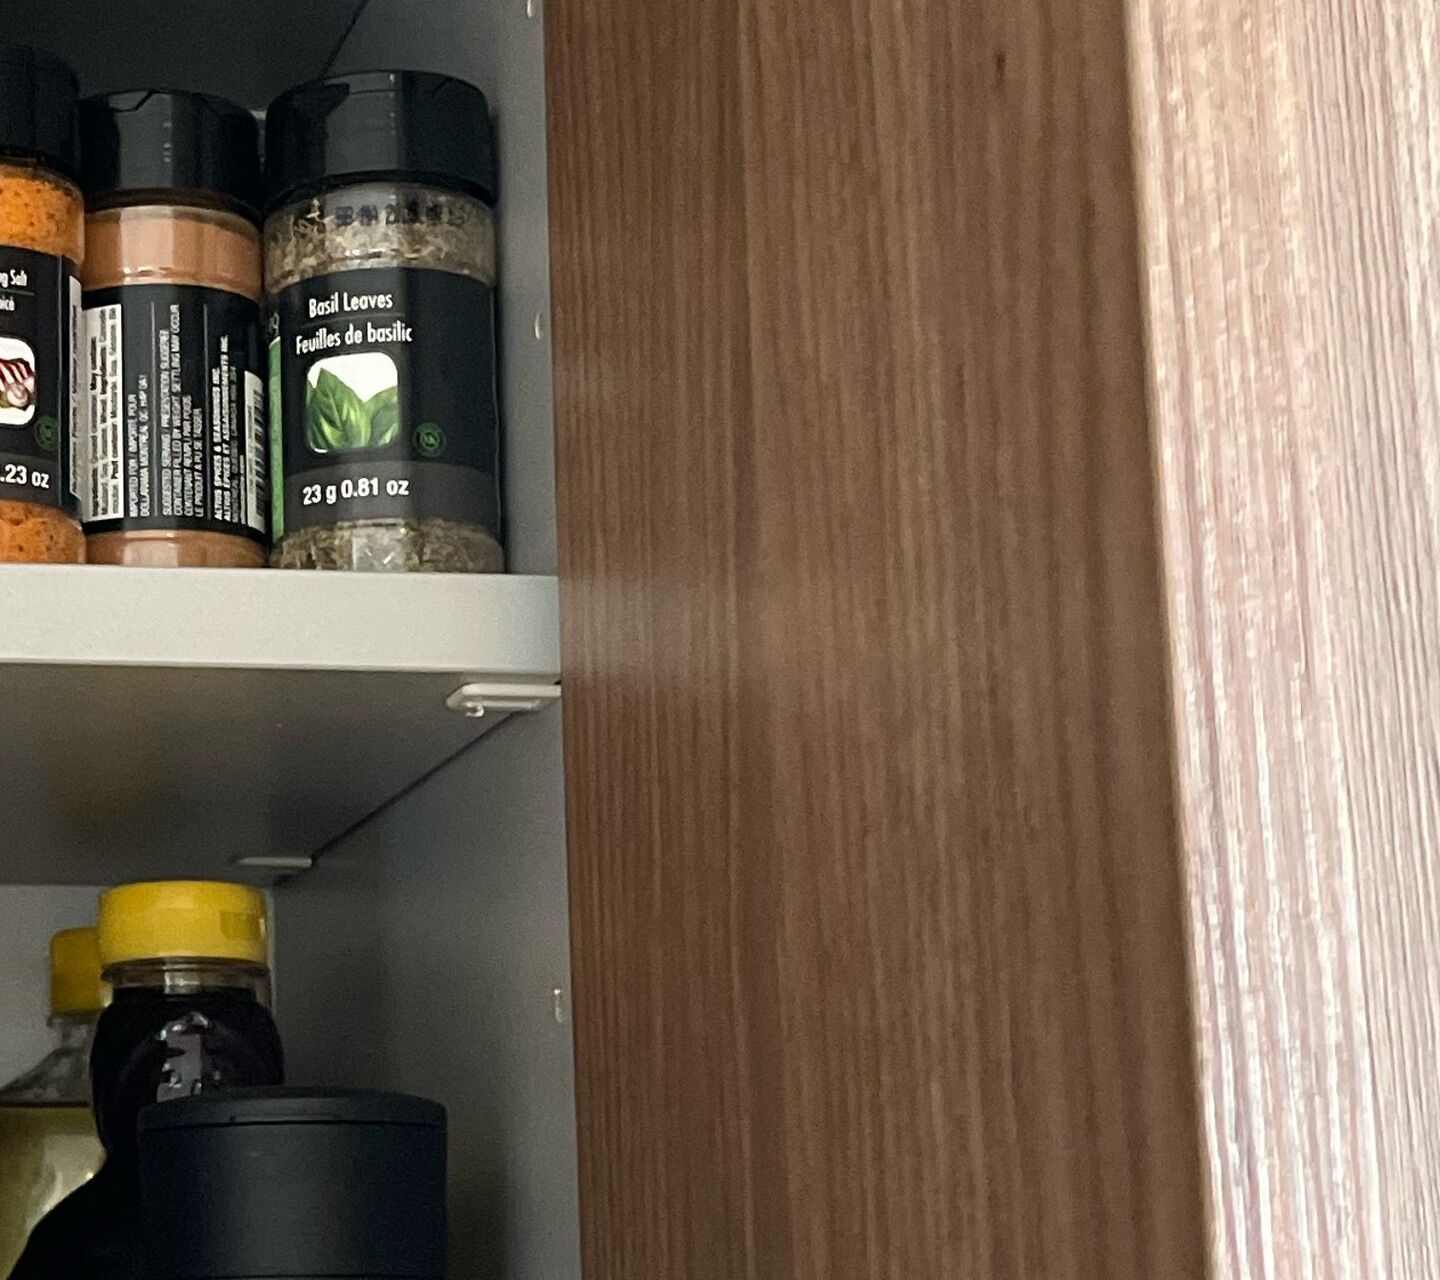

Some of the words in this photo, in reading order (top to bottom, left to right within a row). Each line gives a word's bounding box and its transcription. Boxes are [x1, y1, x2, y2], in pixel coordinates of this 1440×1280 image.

[309, 292, 339, 319] Basil
[343, 292, 393, 312] Leaves
[296, 327, 341, 355] Feuilles
[345, 323, 363, 344] de
[367, 321, 412, 343] basilic
[32, 471, 50, 489] oz
[303, 484, 322, 505] 23
[325, 485, 337, 505] g
[341, 477, 379, 499] 0.81
[386, 479, 409, 496] oz
